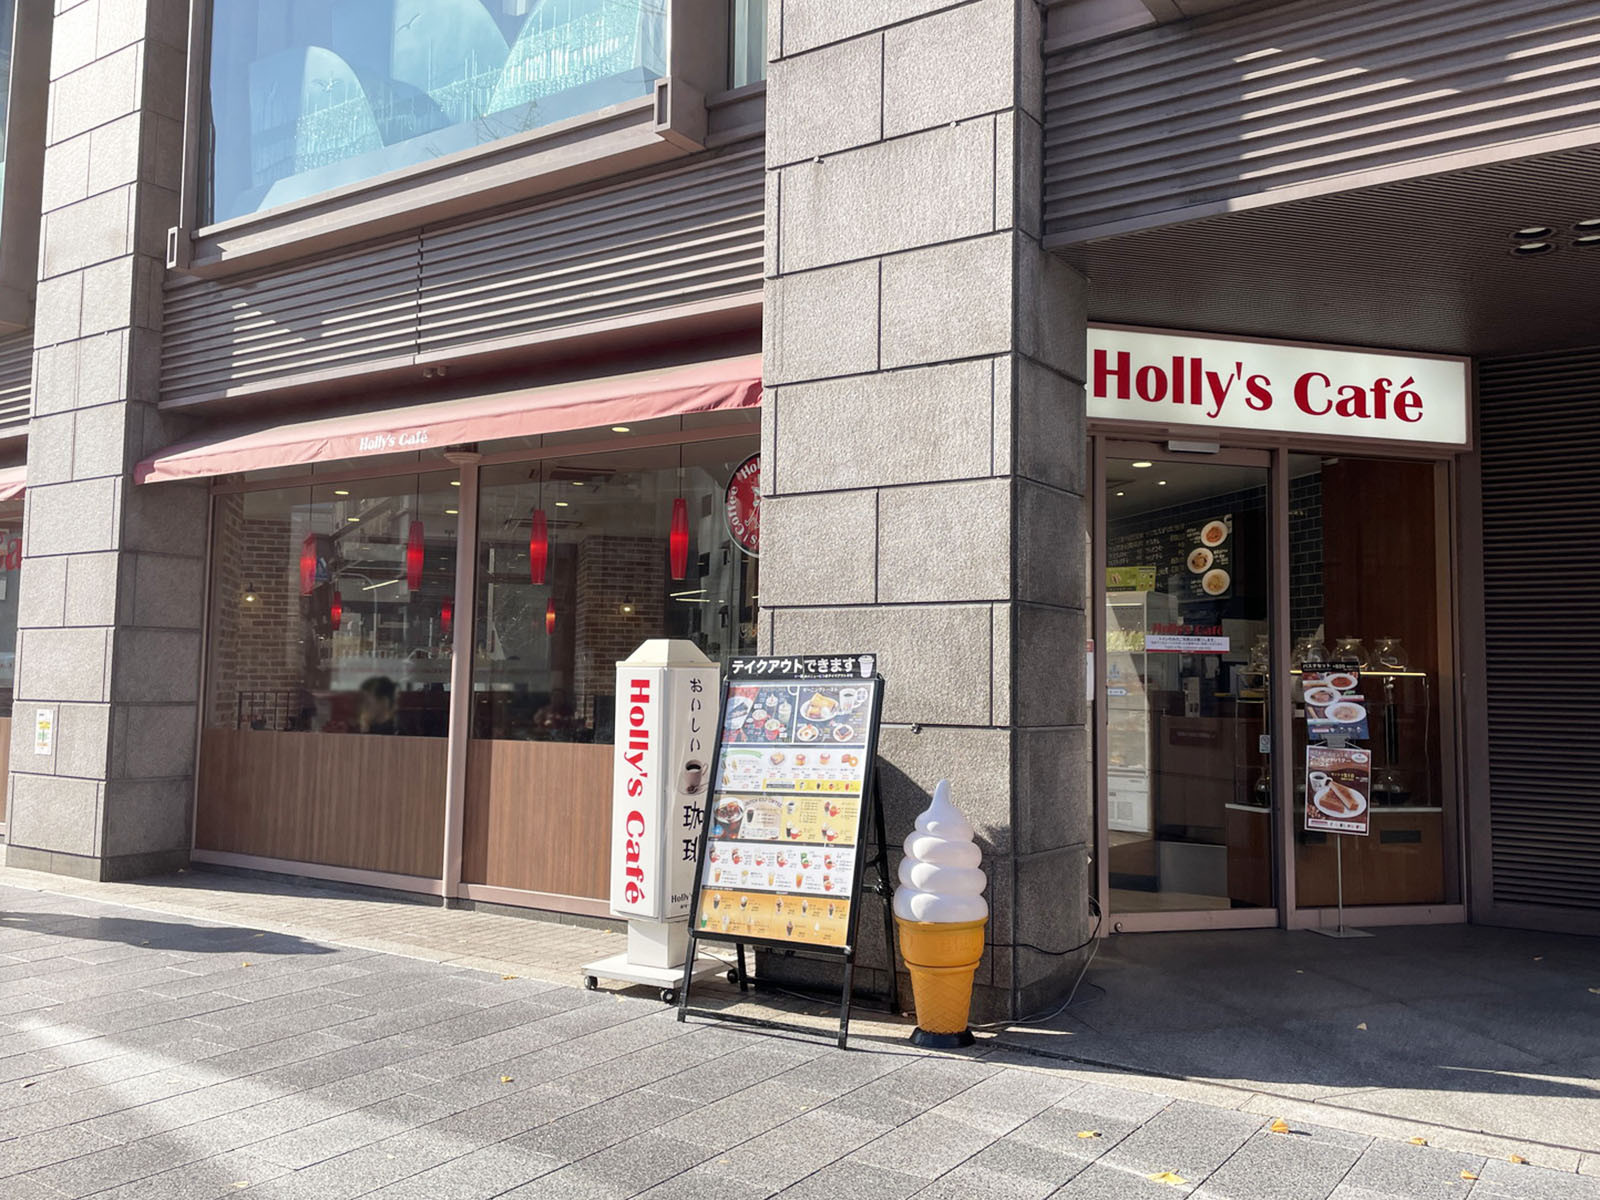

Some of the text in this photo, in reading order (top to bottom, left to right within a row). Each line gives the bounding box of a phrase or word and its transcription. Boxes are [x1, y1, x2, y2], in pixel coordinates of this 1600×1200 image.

[1094, 350, 1423, 423] Holly's Café
[359, 430, 429, 451] Holly's Café
[732, 657, 856, 674] テイクアウトできます
[690, 677, 703, 752] おいしい
[624, 679, 650, 904] Holly's Café
